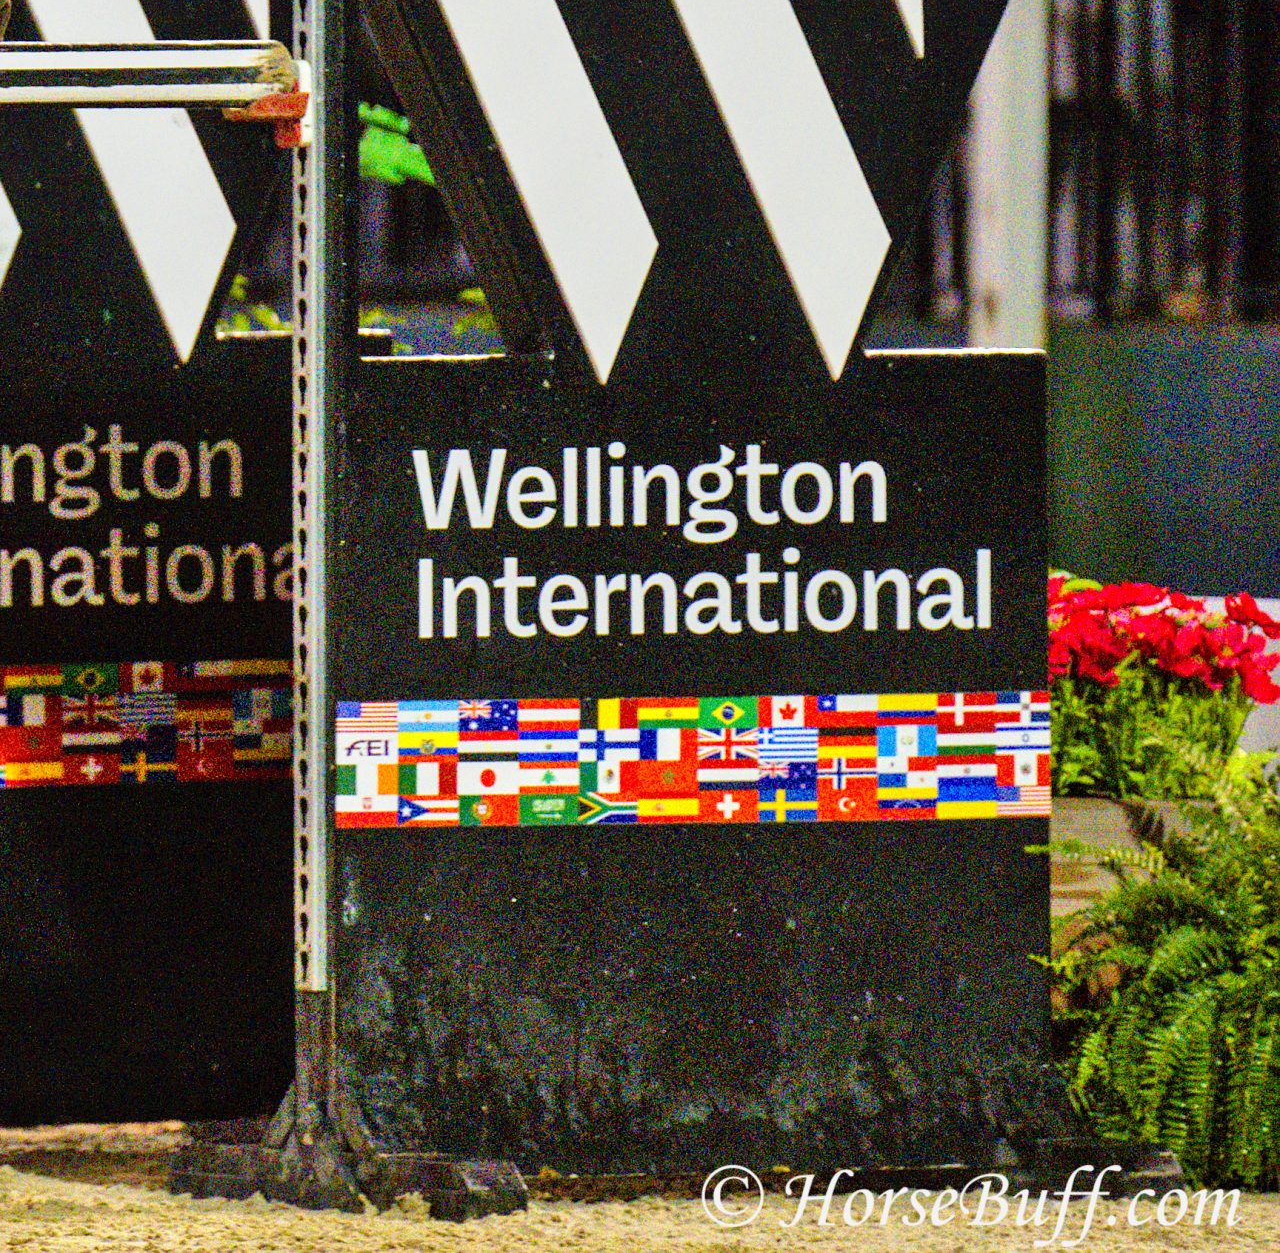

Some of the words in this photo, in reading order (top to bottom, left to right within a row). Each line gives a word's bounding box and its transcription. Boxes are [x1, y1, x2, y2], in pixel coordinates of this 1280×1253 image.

[411, 441, 888, 544] Wellington
[418, 547, 992, 639] International
[345, 739, 389, 757] FEI
